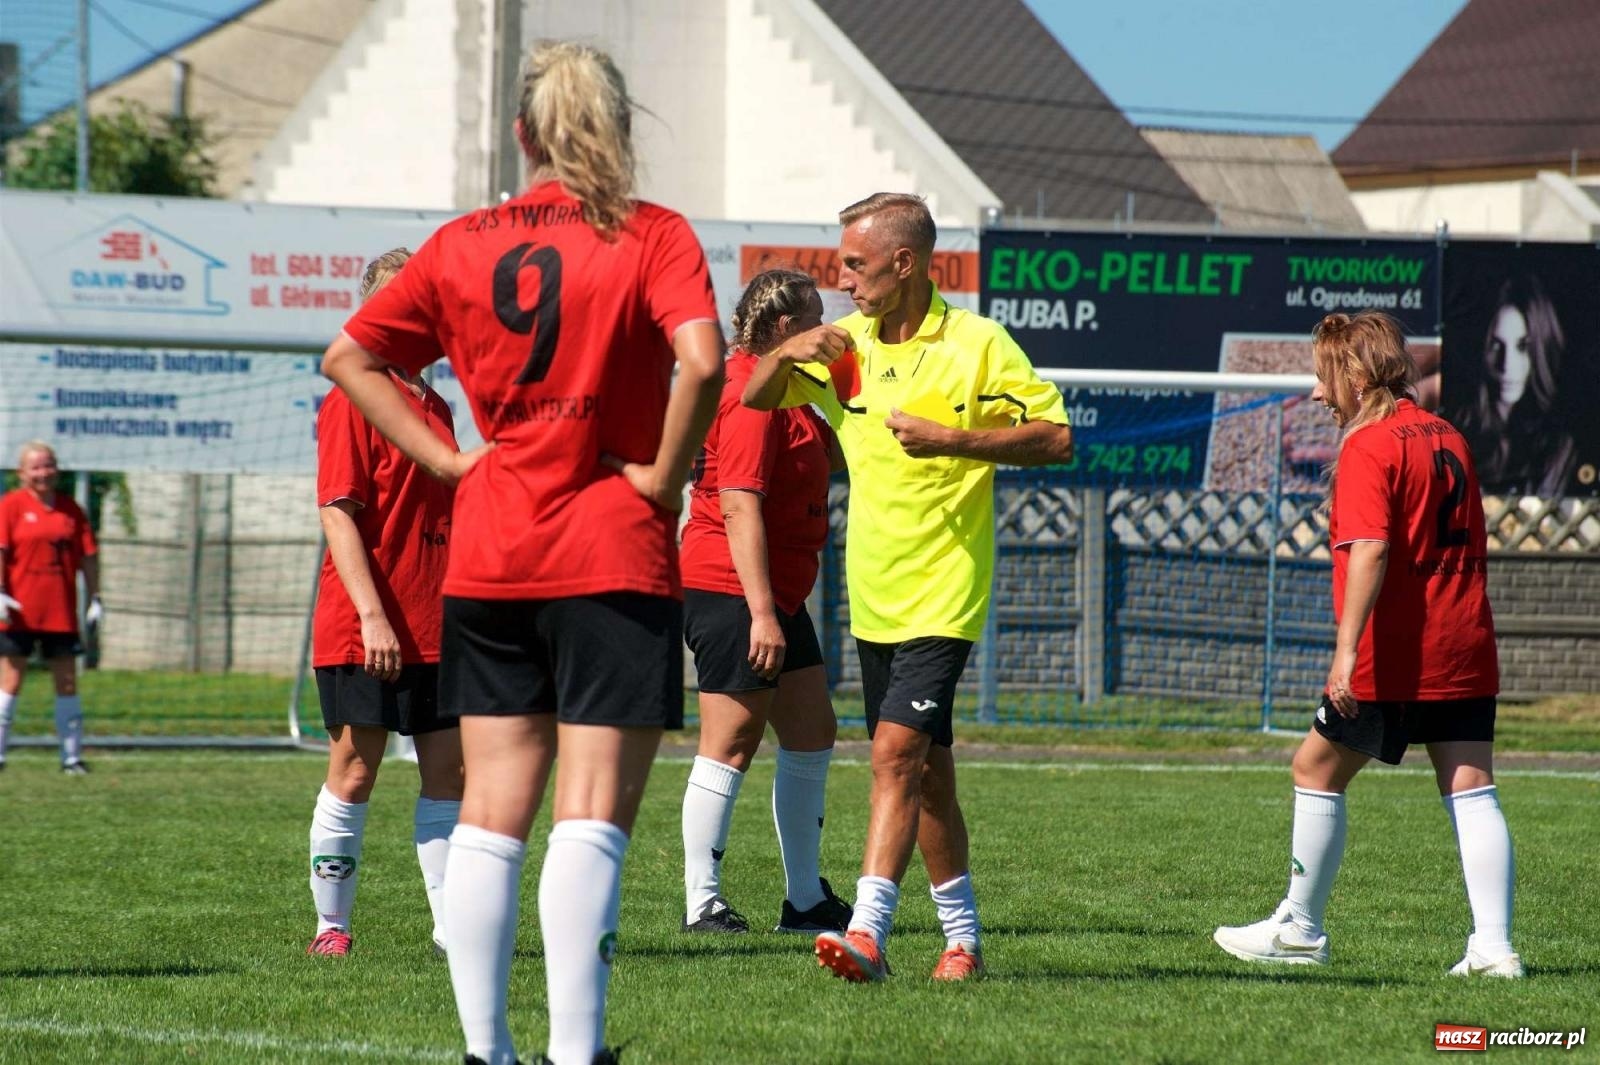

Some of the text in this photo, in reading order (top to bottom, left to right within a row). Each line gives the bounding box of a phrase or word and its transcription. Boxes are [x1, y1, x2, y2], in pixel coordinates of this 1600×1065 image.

[509, 203, 590, 230] TWORK
[71, 269, 185, 291] DAW-BUD
[250, 253, 364, 279] tel. 604 507
[929, 253, 962, 291] 50
[989, 248, 1253, 296] EKO-PELLET
[1287, 253, 1424, 284] TWORKÓW
[250, 284, 353, 310] ul. Główna
[1286, 286, 1423, 311] ul. Ogrodowa 61
[493, 241, 563, 386] 9
[990, 298, 1099, 331] BUBA P.
[1087, 443, 1137, 473] 742
[1142, 445, 1191, 475] 974
[1432, 447, 1470, 548] 2
